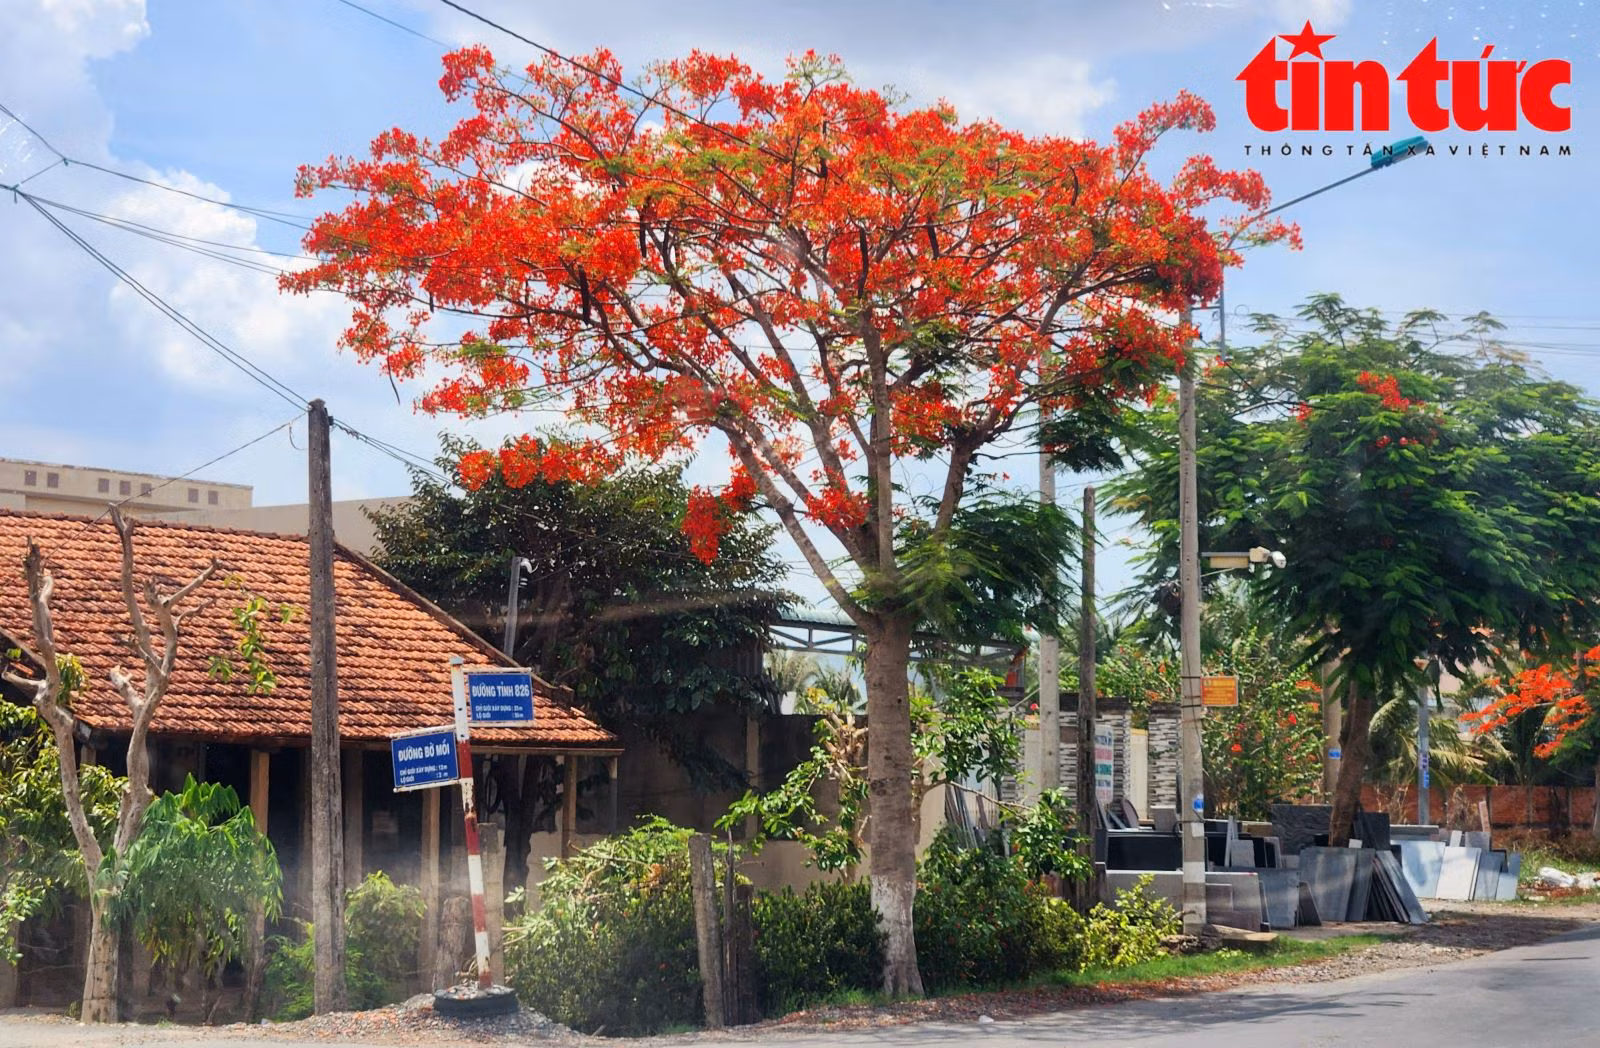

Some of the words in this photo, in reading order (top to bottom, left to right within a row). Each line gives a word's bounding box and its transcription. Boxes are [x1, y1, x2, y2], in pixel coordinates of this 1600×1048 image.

[472, 682, 496, 697] ĐƯỜNG
[497, 681, 513, 697] TỈNH
[514, 684, 529, 697] 826
[398, 745, 423, 761] ĐƯỜNG
